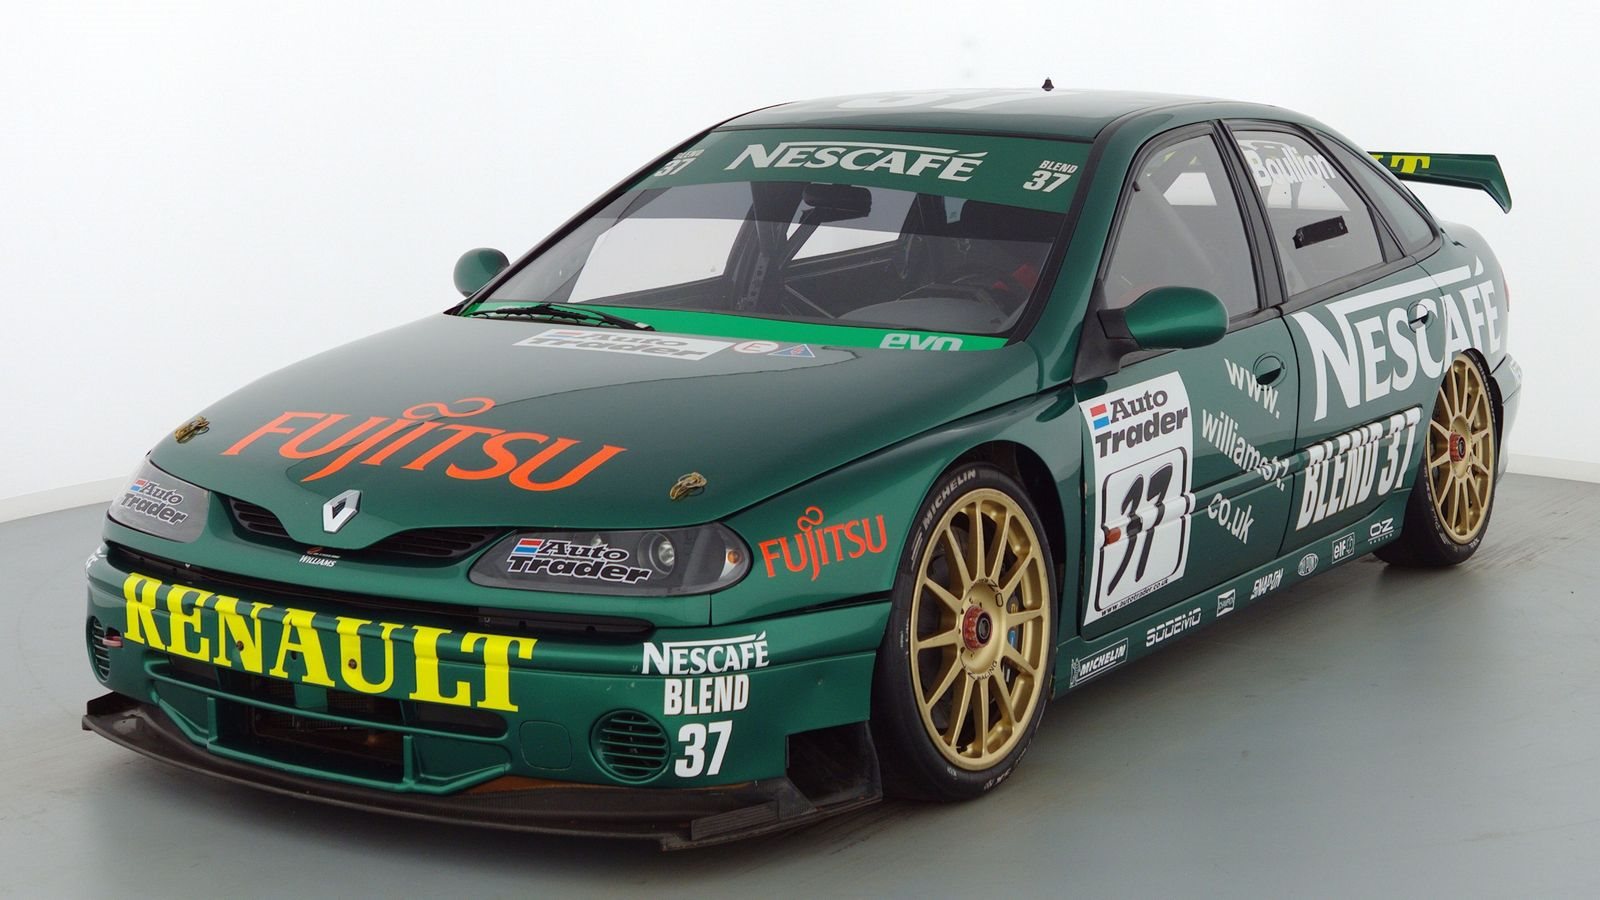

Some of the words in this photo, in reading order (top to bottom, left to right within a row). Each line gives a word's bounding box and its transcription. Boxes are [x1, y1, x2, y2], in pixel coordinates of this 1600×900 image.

[654, 158, 697, 177] 37
[723, 141, 988, 183] NESCAFÉ
[1022, 169, 1072, 193] 37
[1039, 160, 1079, 174] BLEND
[1291, 256, 1502, 422] NESCAFÉ
[1110, 389, 1168, 424] Auto
[1224, 358, 1280, 420] www.
[220, 397, 629, 491] FUJITSU
[1095, 406, 1189, 459] Trader
[1296, 420, 1384, 531] BLEND
[1377, 406, 1424, 497] 37
[120, 492, 189, 525] Trader
[141, 481, 184, 505] Auto
[922, 468, 976, 531] MICHELIN
[1107, 461, 1173, 596] 37
[1207, 492, 1254, 544] co.uk
[299, 554, 337, 567] WILLIAMS
[535, 539, 630, 561] Auto
[758, 505, 888, 581] FUJITSU
[1333, 539, 1347, 560] elf
[507, 554, 653, 584] Trader
[123, 572, 538, 712] RENAULT
[641, 630, 770, 676] NESCAFÉ
[1079, 644, 1127, 677] MICHELIN
[663, 674, 750, 716] BLEND
[674, 720, 733, 779] 37
